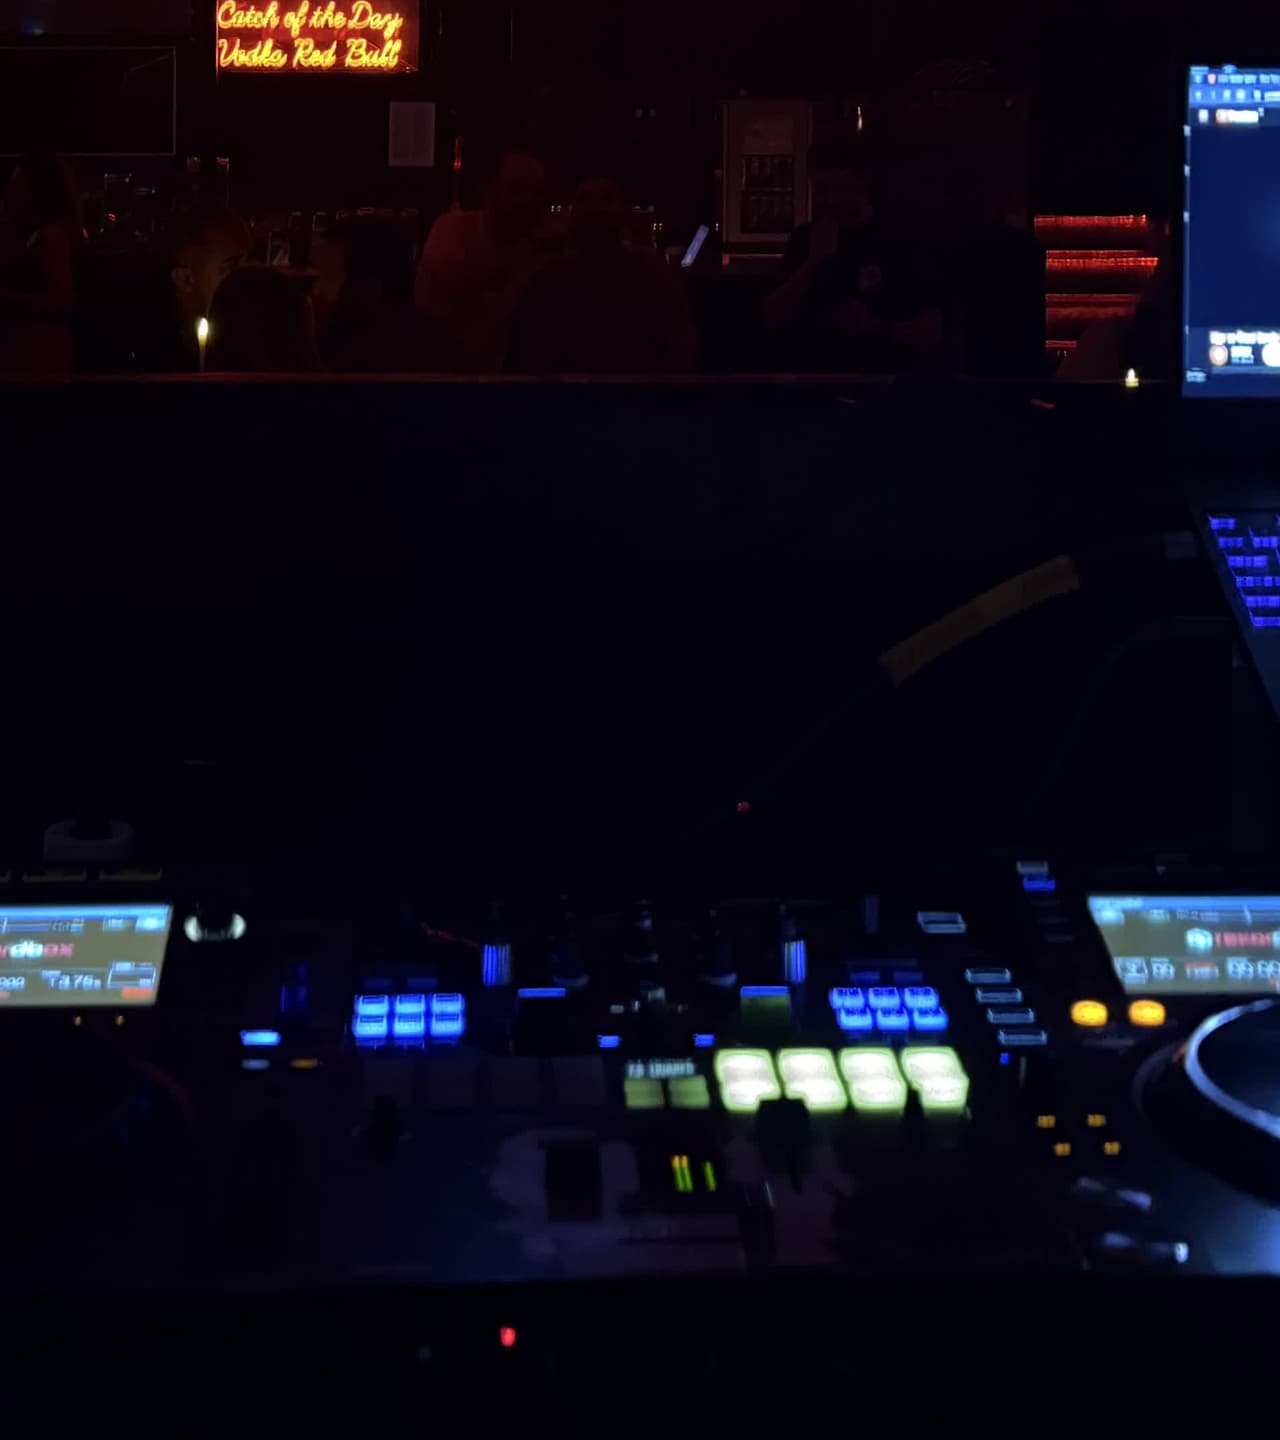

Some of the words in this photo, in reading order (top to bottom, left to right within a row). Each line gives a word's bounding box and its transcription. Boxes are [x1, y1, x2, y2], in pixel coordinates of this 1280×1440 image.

[218, 0, 280, 29] Catch
[283, 0, 309, 37] of
[310, 0, 347, 28] the
[348, 0, 403, 40] Day
[218, 38, 288, 68] Vodka
[293, 38, 337, 68] Red
[345, 38, 402, 68] Bull
